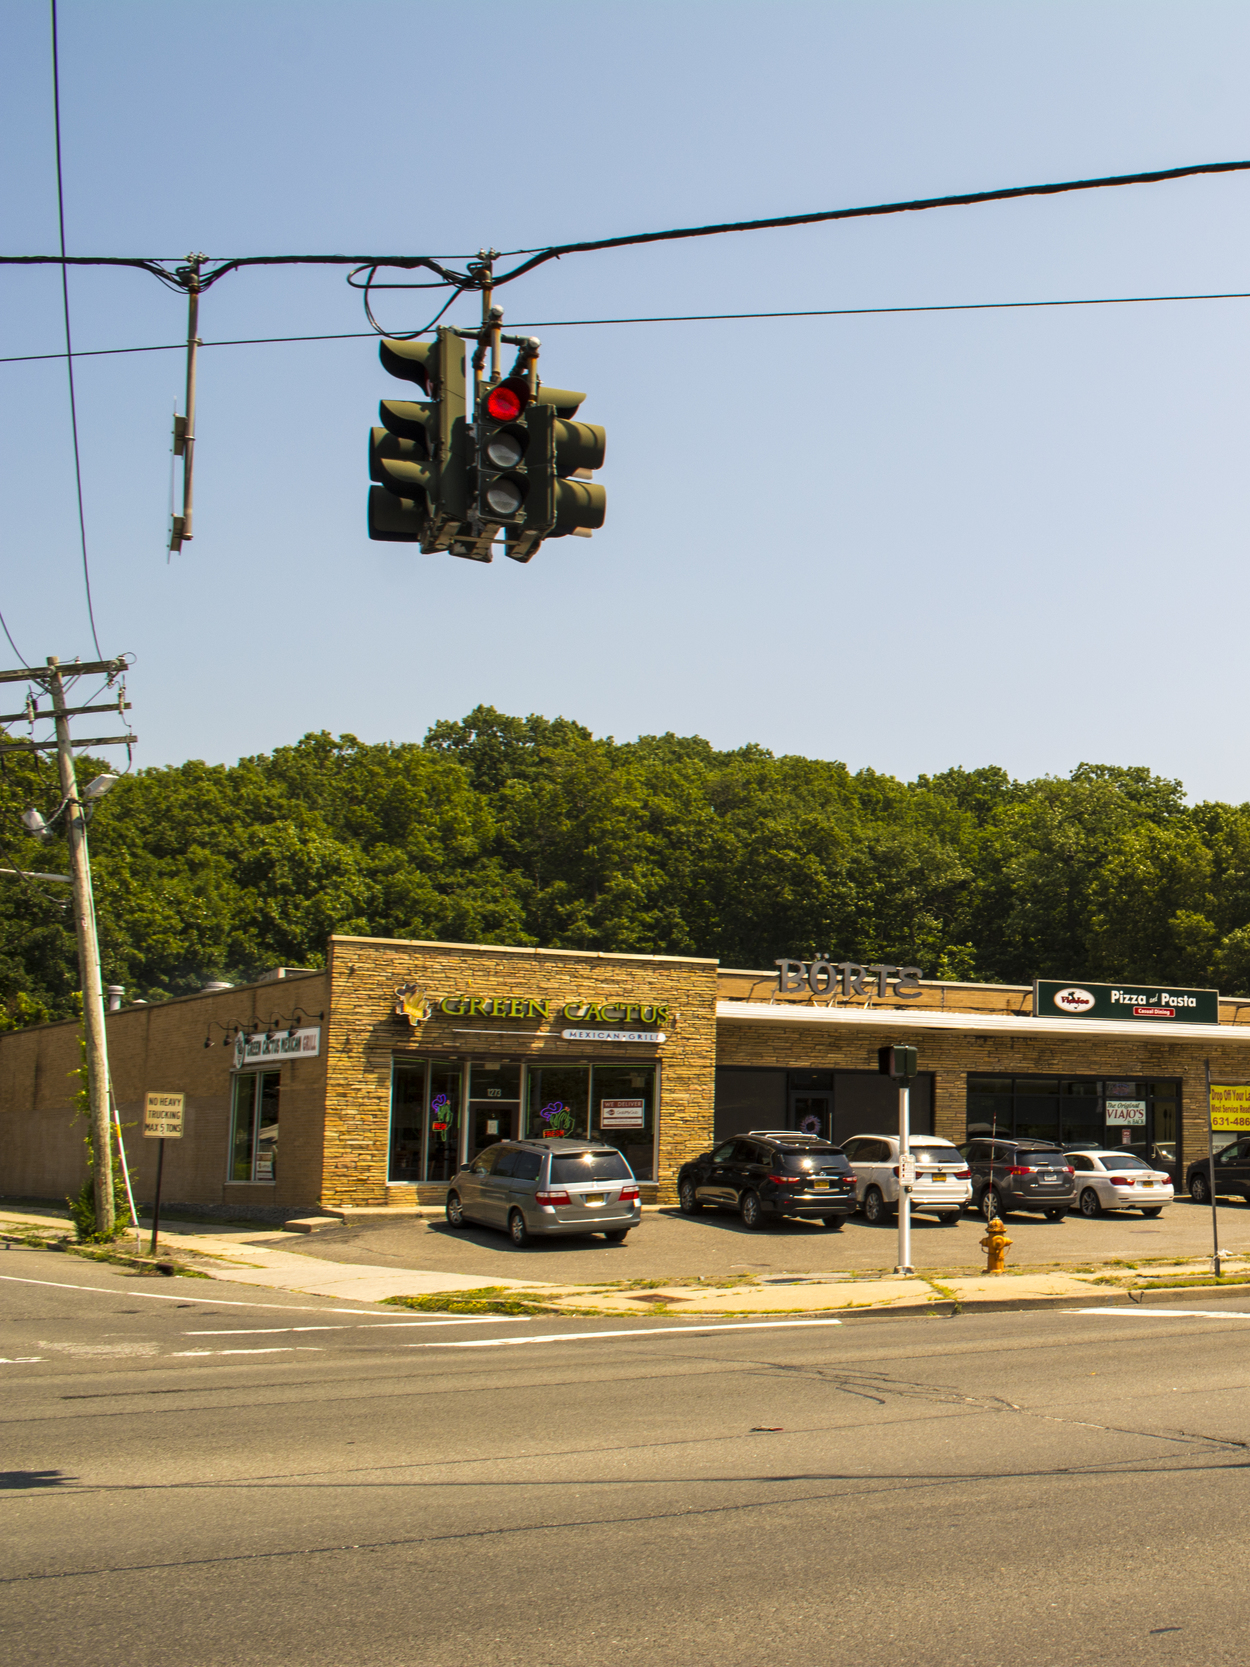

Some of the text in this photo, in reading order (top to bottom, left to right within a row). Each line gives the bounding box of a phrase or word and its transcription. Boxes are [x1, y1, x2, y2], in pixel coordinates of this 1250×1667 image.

[775, 952, 924, 999] BÖRTE
[1111, 990, 1197, 1007] Pizza and Pasta
[441, 994, 549, 1019] GREEN
[563, 1000, 671, 1026] CACTUS
[569, 1031, 620, 1040] MEXICAN
[487, 1088, 502, 1097] 1273
[1211, 1089, 1223, 1103] Drop
[1232, 1089, 1244, 1101] Your
[149, 1097, 182, 1106] NO HEAVY
[1211, 1104, 1222, 1113] Most
[1222, 1105, 1239, 1114] Service
[148, 1110, 181, 1119] TRUCKING
[1107, 1109, 1144, 1121] VIAJO'S
[145, 1123, 159, 1131] MAX
[166, 1123, 182, 1132] TONS
